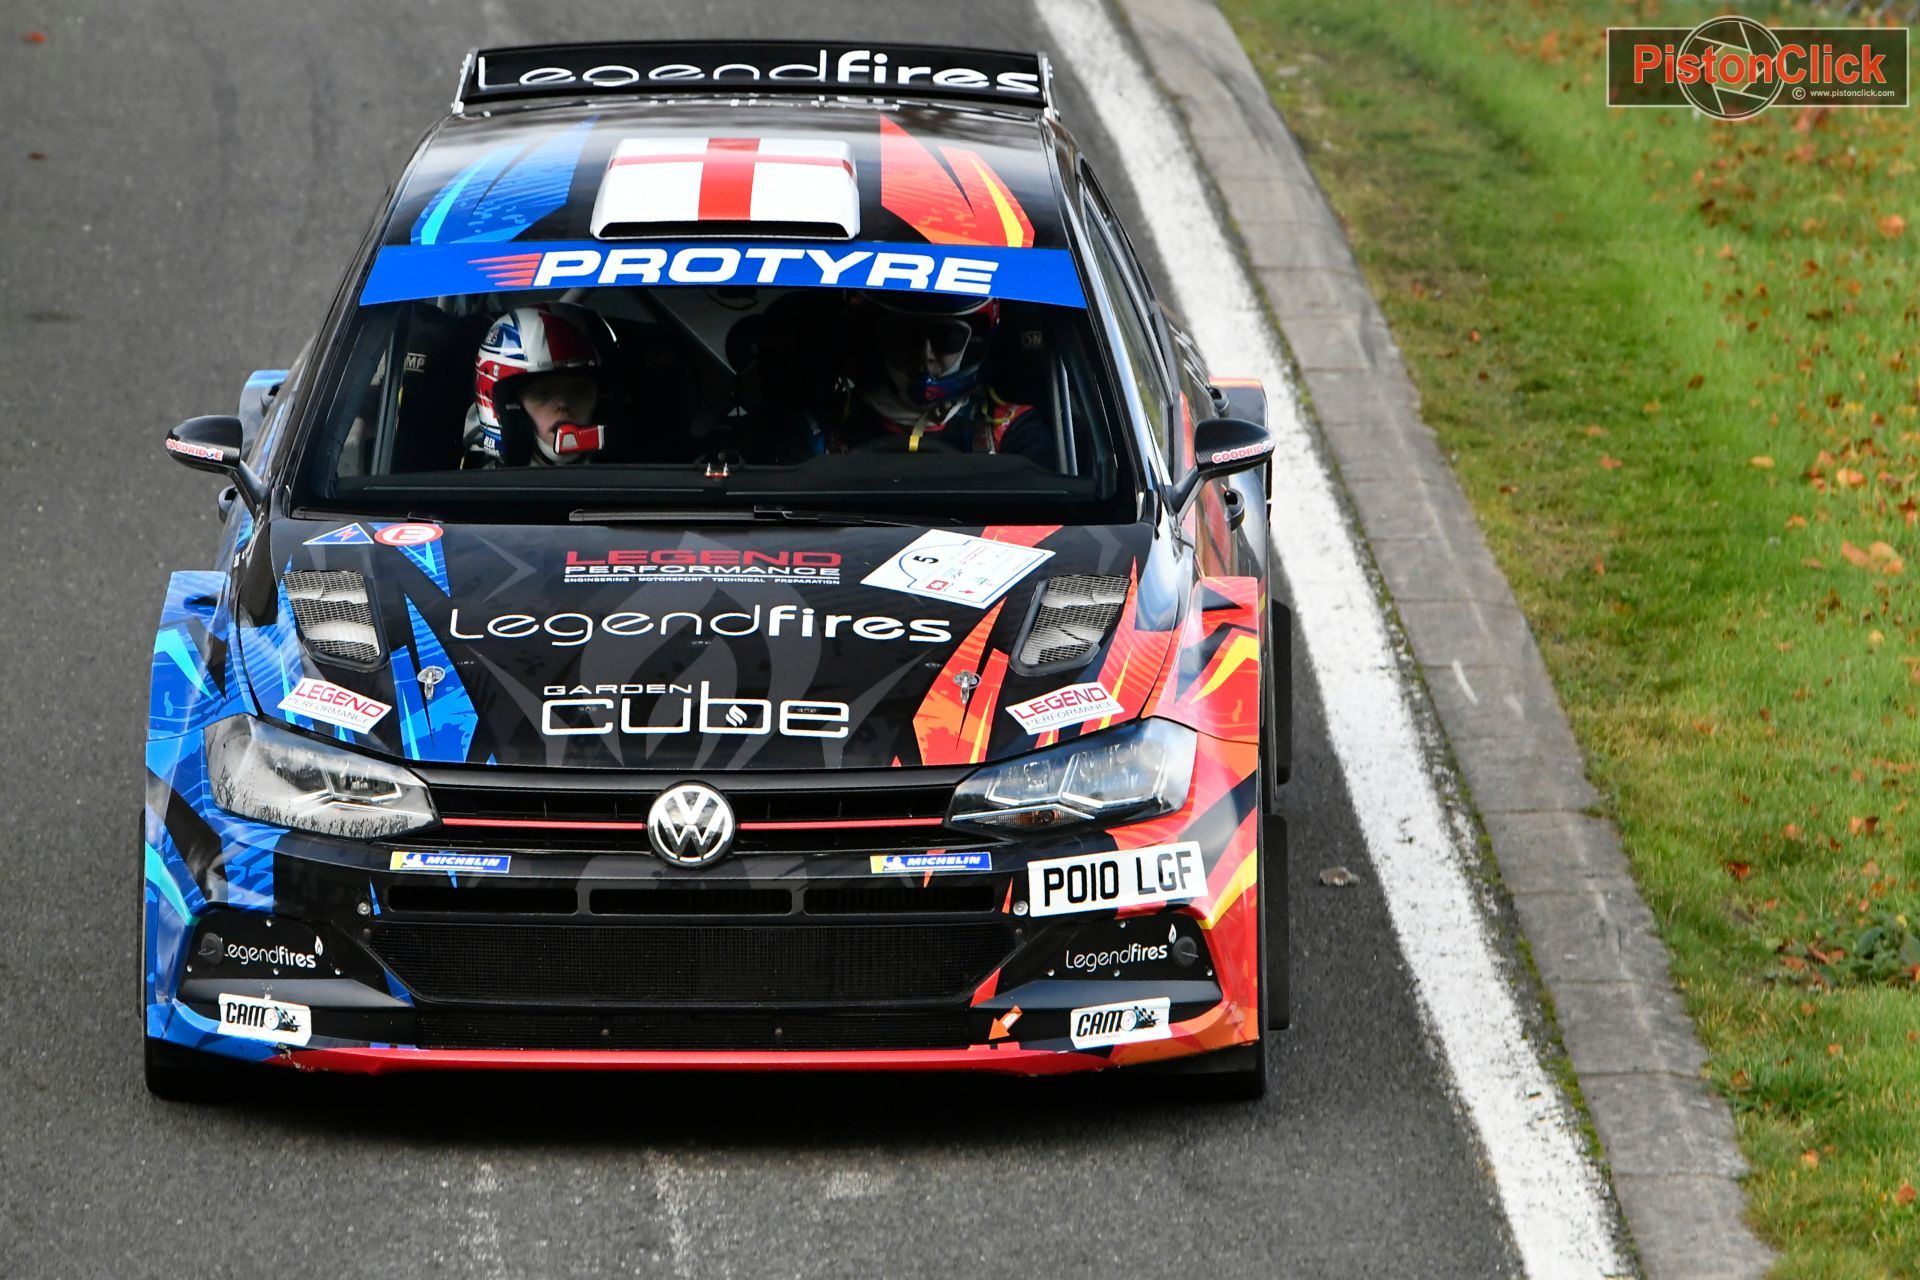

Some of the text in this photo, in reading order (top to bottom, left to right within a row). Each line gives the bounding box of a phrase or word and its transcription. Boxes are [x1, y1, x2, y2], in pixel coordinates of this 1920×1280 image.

[478, 49, 1039, 93] Legendfires
[534, 247, 999, 294] PROTYRE
[565, 565, 840, 576] PERFORMANCE
[566, 549, 842, 567] LEGEND
[913, 555, 939, 564] 5
[450, 604, 952, 646] Legendfires
[295, 682, 384, 718] LEGEND
[543, 684, 693, 695] GARDEN
[1014, 687, 1108, 719] LEGEND
[288, 697, 369, 725] PERFORMANCE
[541, 681, 850, 738] cube
[1024, 700, 1115, 727] PERFORMANCE
[425, 856, 501, 867] MICHELIN
[907, 856, 982, 866] MICHELIN
[1136, 850, 1192, 896] LGF
[1065, 943, 1168, 972] Legendfires
